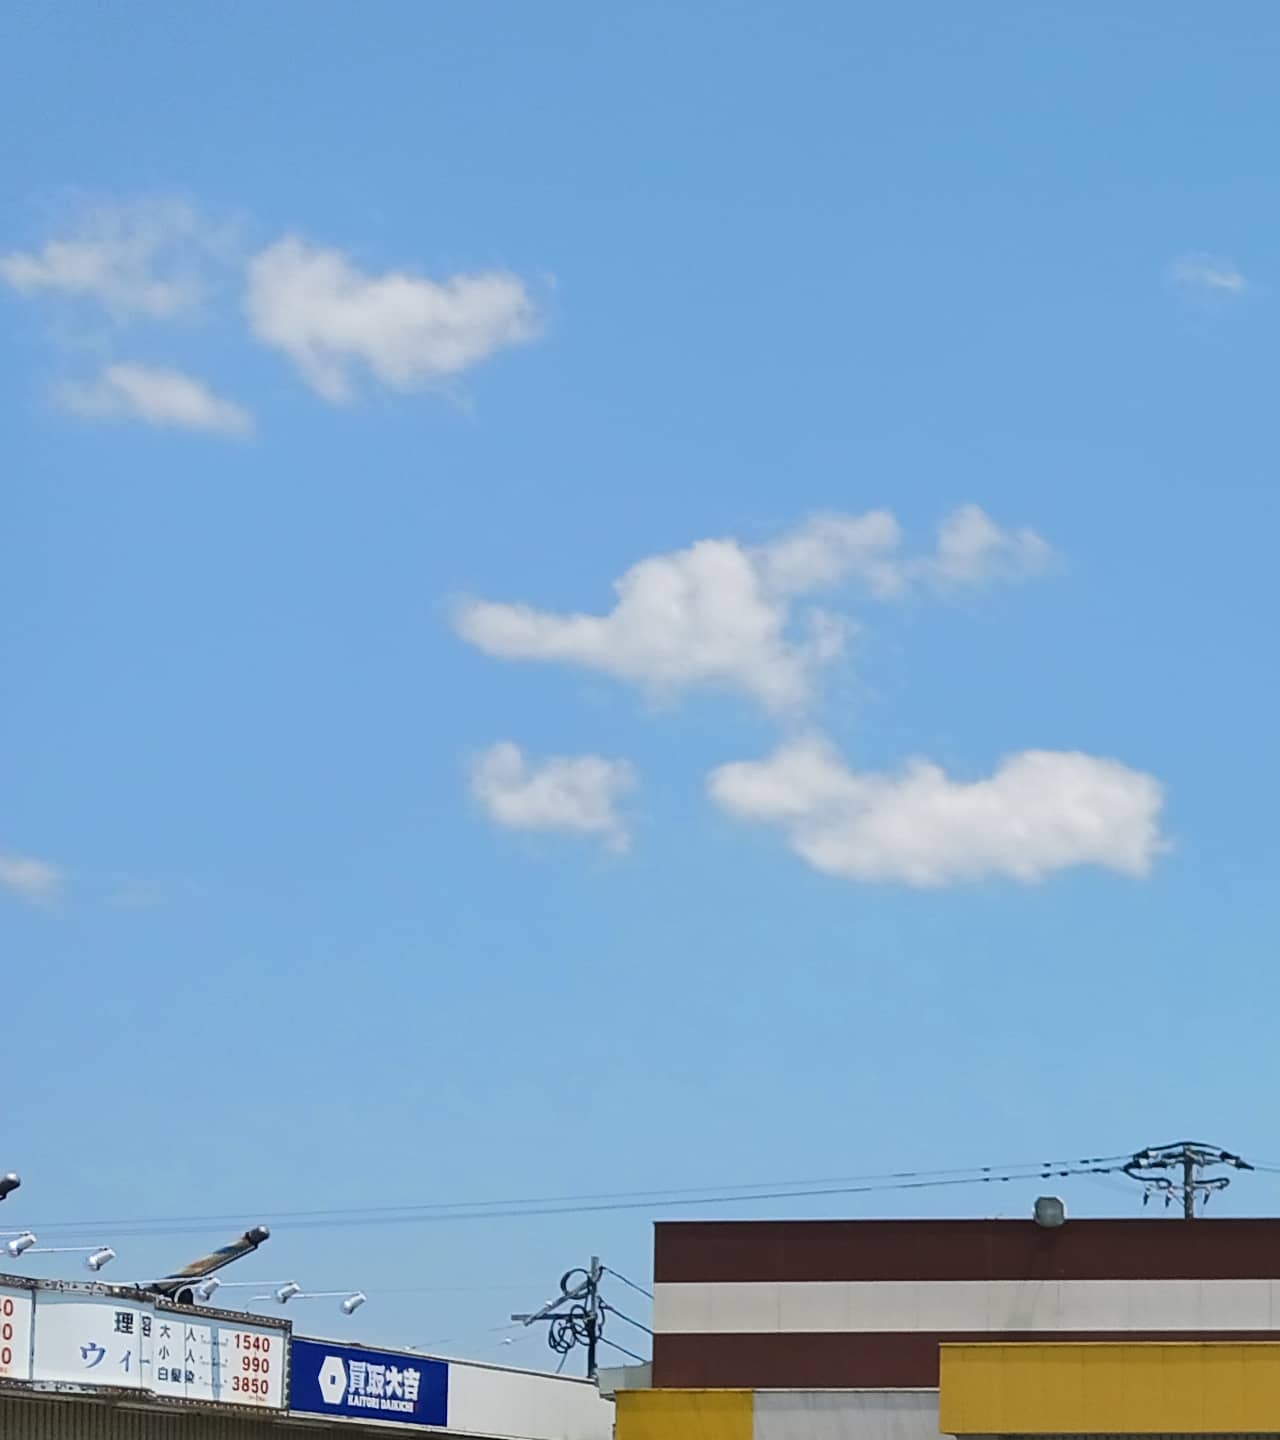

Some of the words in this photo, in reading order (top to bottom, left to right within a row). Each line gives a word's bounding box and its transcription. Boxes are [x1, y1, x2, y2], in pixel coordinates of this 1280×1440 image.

[234, 1333, 271, 1353] 1540
[242, 1356, 270, 1374] 990
[231, 1376, 269, 1395] 3850
[348, 1359, 421, 1401] 買取大吉
